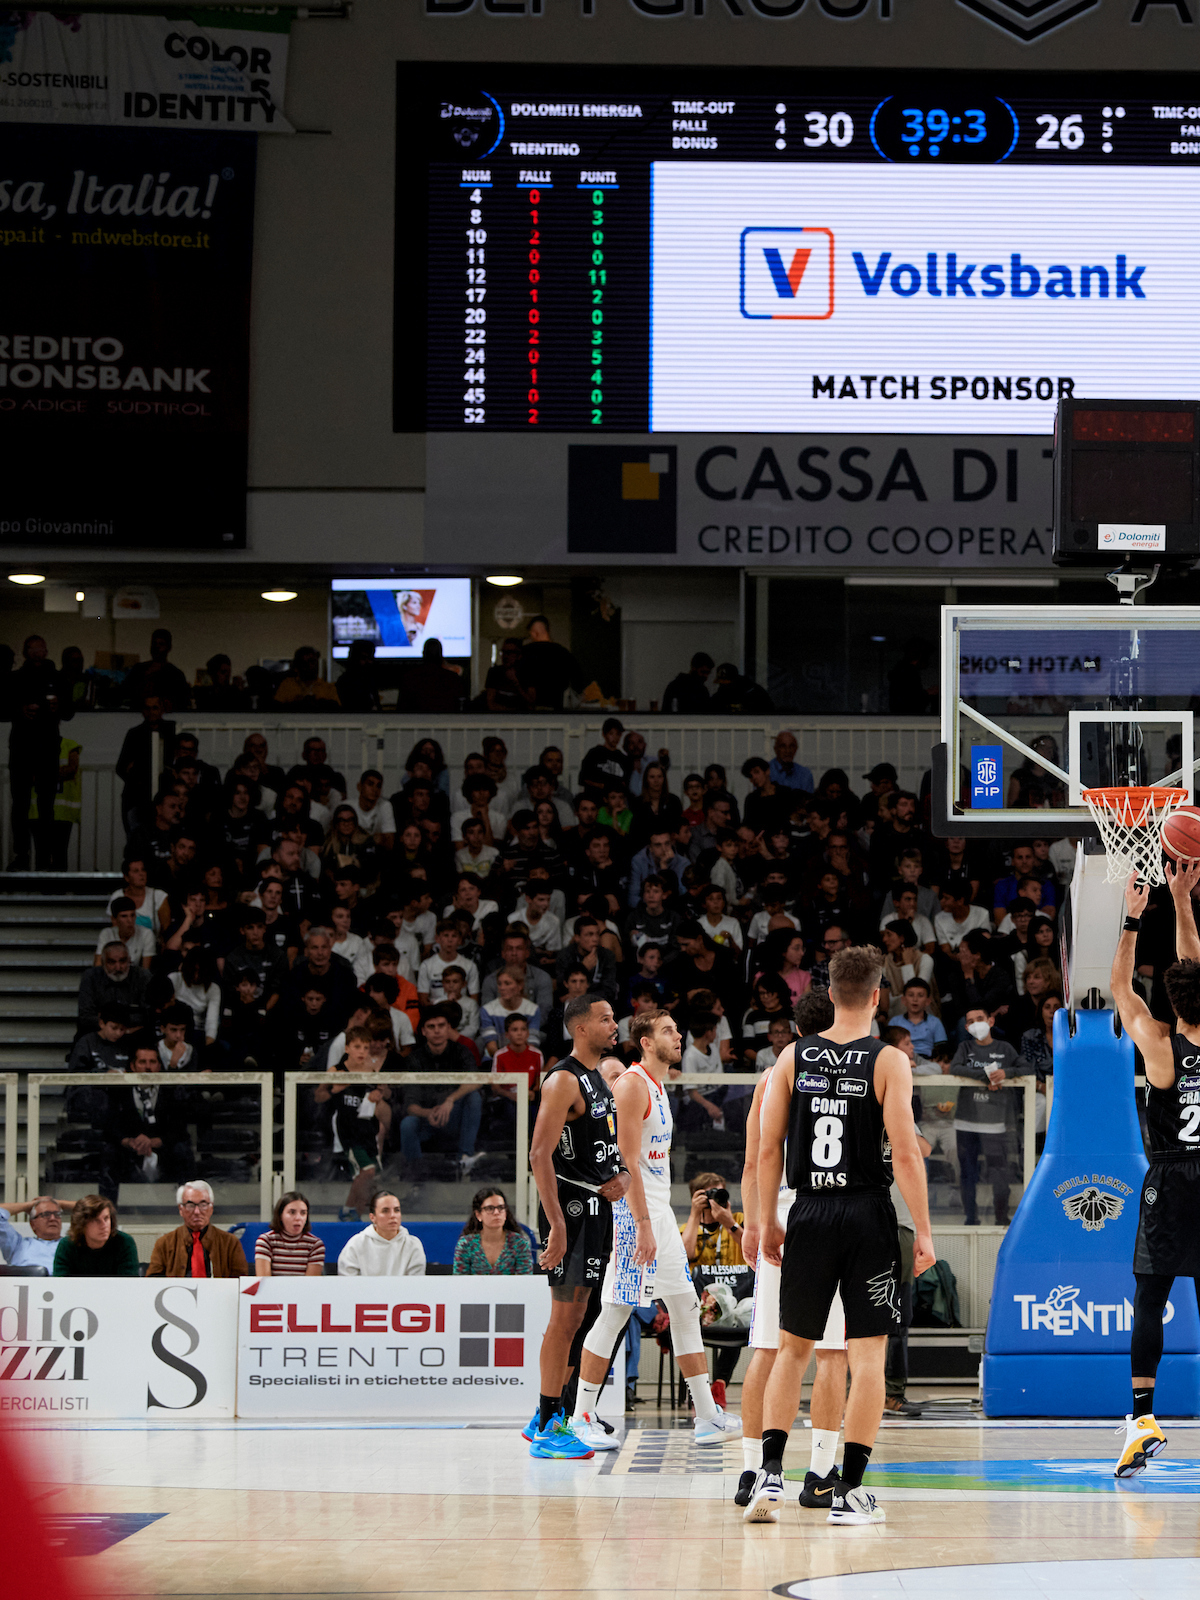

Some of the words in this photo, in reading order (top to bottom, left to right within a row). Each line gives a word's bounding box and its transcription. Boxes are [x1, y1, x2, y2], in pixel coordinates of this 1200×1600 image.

[164, 33, 270, 74] COLOR
[0, 73, 108, 89] -SOSTENIBILI
[124, 92, 275, 122] IDENTITY
[511, 104, 580, 116] DOLOMITI
[583, 105, 642, 117] ENERGIA
[672, 101, 735, 114] TIME-OUT
[673, 120, 707, 131] FALLI
[775, 119, 786, 134] 4
[804, 112, 854, 147] 30
[901, 109, 987, 143] 39:3
[1036, 114, 1084, 149] 26
[1102, 122, 1113, 137] 5
[510, 143, 580, 155] TRENTINO
[672, 137, 718, 149] BONUS
[462, 170, 491, 181] NUM
[520, 171, 551, 182] FALLI
[580, 171, 616, 183] PUNTI
[67, 169, 219, 219] Italia!
[470, 189, 482, 204] 4
[593, 190, 603, 205] 0
[470, 209, 482, 224] 8
[592, 211, 603, 225] 3
[72, 227, 210, 248] mdwebstore.it
[466, 229, 487, 244] 10
[592, 231, 603, 245] 0
[466, 248, 484, 264] 11
[592, 250, 603, 265] 0
[467, 268, 486, 284] 12
[589, 270, 606, 285] 11
[852, 252, 1146, 298] Volksbank
[466, 288, 486, 302] 17
[593, 290, 602, 303] 2
[465, 308, 486, 324] 20
[592, 310, 603, 325] 0
[465, 329, 486, 344] 22
[592, 331, 602, 345] 3
[464, 348, 485, 364] 24
[592, 349, 602, 365] 5
[464, 368, 486, 384] 44
[591, 369, 602, 384] 4
[812, 375, 919, 399] MATCH
[930, 376, 1075, 400] SPONSOR
[463, 388, 485, 404] 45
[591, 389, 602, 404] 0
[21, 399, 86, 413] ADIGE
[107, 400, 211, 416] SÜDTIROL
[464, 408, 485, 423] 52
[592, 409, 602, 424] 2
[695, 445, 928, 503] CASSA
[955, 448, 1018, 503] DI
[25, 518, 114, 535] Giovannini
[699, 525, 852, 554] CREDITO
[1118, 532, 1161, 541] Dolomiti
[1131, 541, 1160, 549] energia
[974, 786, 1000, 796] FIP
[801, 1046, 870, 1066] CAVIT
[797, 1078, 828, 1089] Melinda
[811, 1096, 848, 1115] CONTI
[811, 1116, 844, 1168] 8
[811, 1172, 848, 1187] ITAS
[1053, 1174, 1090, 1198] AQUILA
[1092, 1173, 1134, 1196] BASKET
[714, 1275, 737, 1285] ITAS
[249, 1303, 446, 1333] ELLEGI
[255, 1347, 446, 1368] TRENTO
[249, 1374, 341, 1387] Specialisti
[345, 1374, 360, 1386] in
[364, 1374, 448, 1386] etichette
[451, 1374, 524, 1386] adesive.
